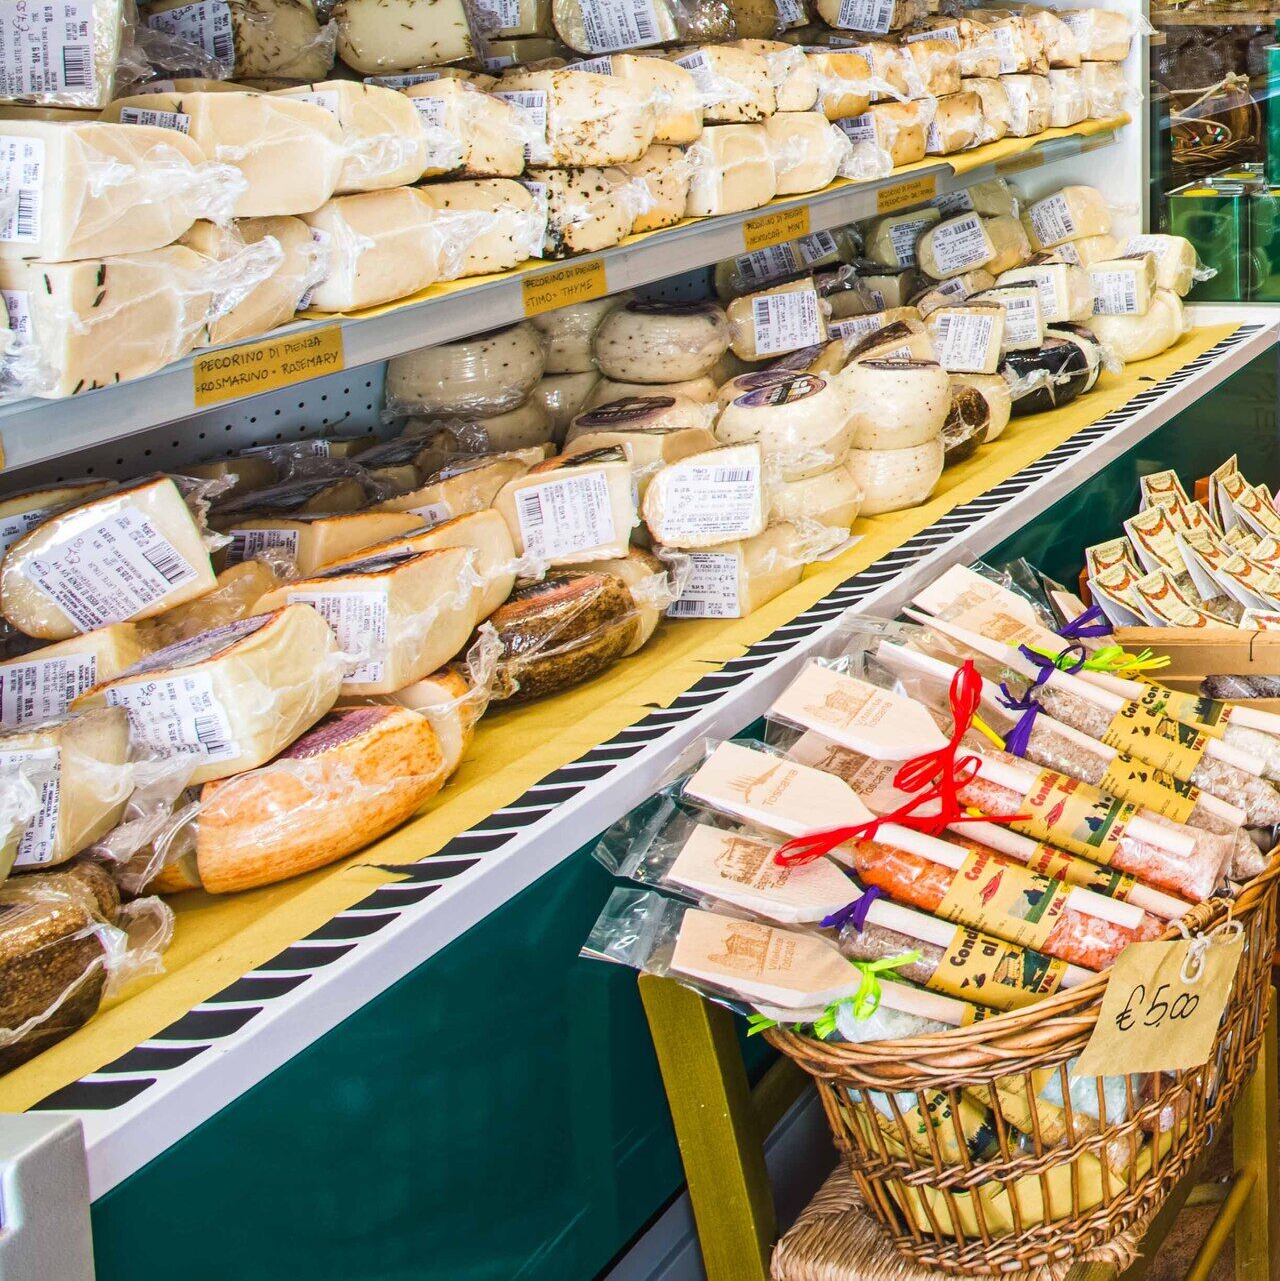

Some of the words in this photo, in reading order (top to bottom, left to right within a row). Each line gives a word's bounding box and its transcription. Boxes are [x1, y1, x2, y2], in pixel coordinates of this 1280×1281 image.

[525, 270, 565, 290] PECORINO
[565, 269, 574, 281] DI
[574, 262, 602, 278] PIENZA
[561, 279, 594, 299] THYME
[199, 348, 265, 374] PECORINO
[269, 347, 282, 361] DI
[284, 335, 323, 357] PIENZA
[281, 350, 340, 376] ROSEMARY
[1219, 705, 1234, 725] VAL
[762, 769, 799, 809] Toscana
[859, 765, 893, 797] Toscana
[1108, 823, 1126, 843] VAL
[1047, 896, 1067, 918] VAL
[1038, 971, 1058, 995] VAL
[1115, 983, 1146, 1033] €
